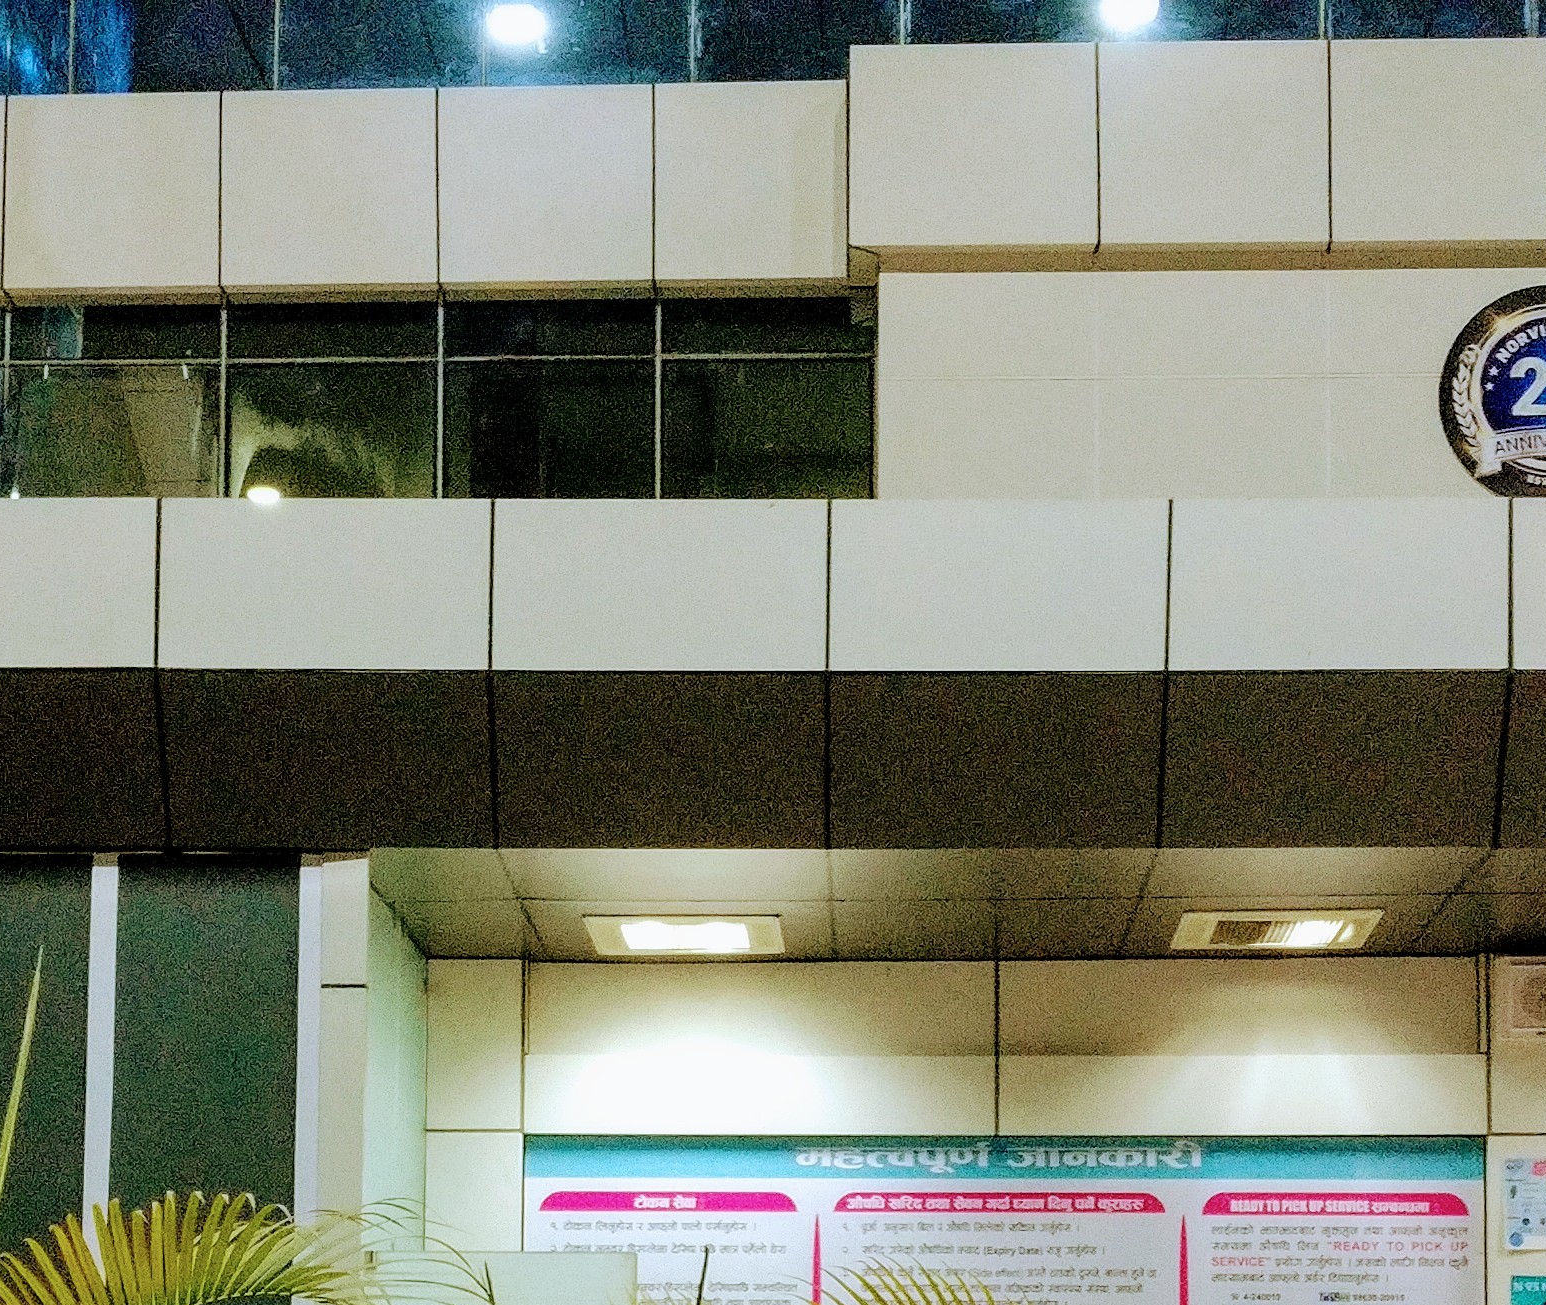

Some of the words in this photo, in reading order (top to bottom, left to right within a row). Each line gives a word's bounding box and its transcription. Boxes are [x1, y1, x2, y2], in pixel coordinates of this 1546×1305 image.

[1230, 1199, 1265, 1213] READY
[1267, 1199, 1280, 1213] TO
[1282, 1199, 1307, 1213] PICK
[1309, 1199, 1323, 1213] UP
[1325, 1199, 1370, 1213] SERVICE
[1388, 1241, 1405, 1251] TO
[1411, 1241, 1443, 1251] PICK
[1451, 1241, 1469, 1251] UP
